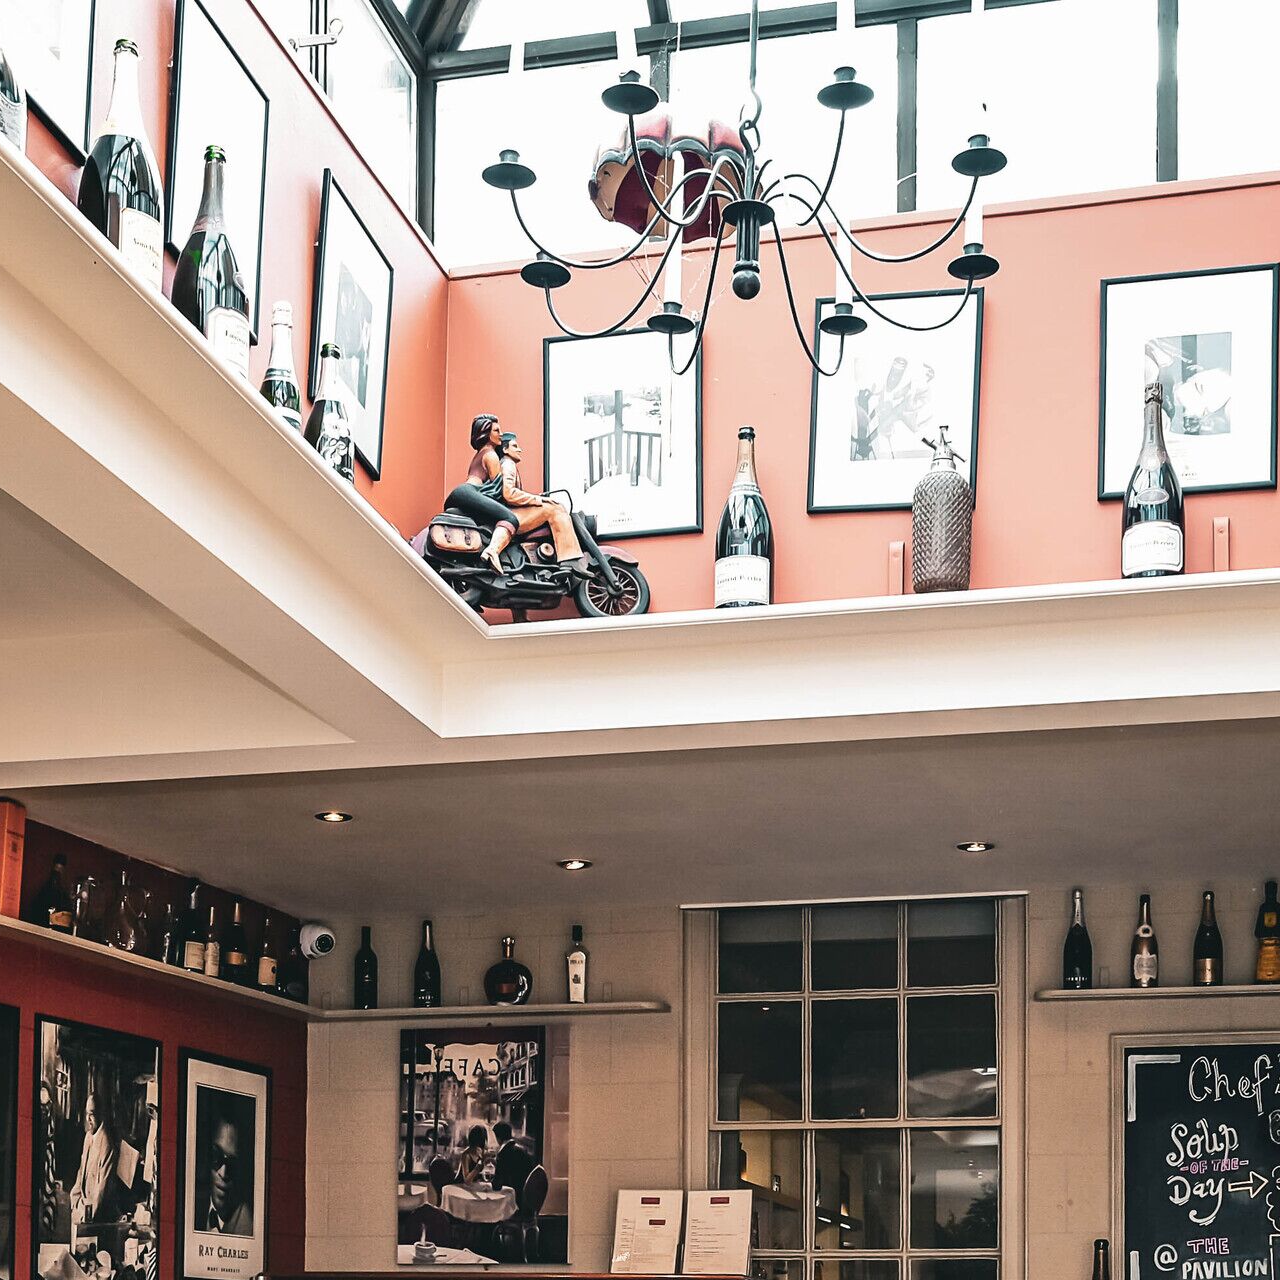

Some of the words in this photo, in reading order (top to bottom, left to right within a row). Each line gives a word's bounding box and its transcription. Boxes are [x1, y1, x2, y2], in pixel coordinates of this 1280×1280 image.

[1166, 1117, 1239, 1167] Soup
[1166, 1174, 1225, 1226] Day
[198, 1244, 215, 1257] RAY
[217, 1246, 249, 1260] CHARLES
[1153, 1243, 1178, 1272] @
[1186, 1237, 1230, 1255] THE
[1182, 1258, 1268, 1280] PAVILION
